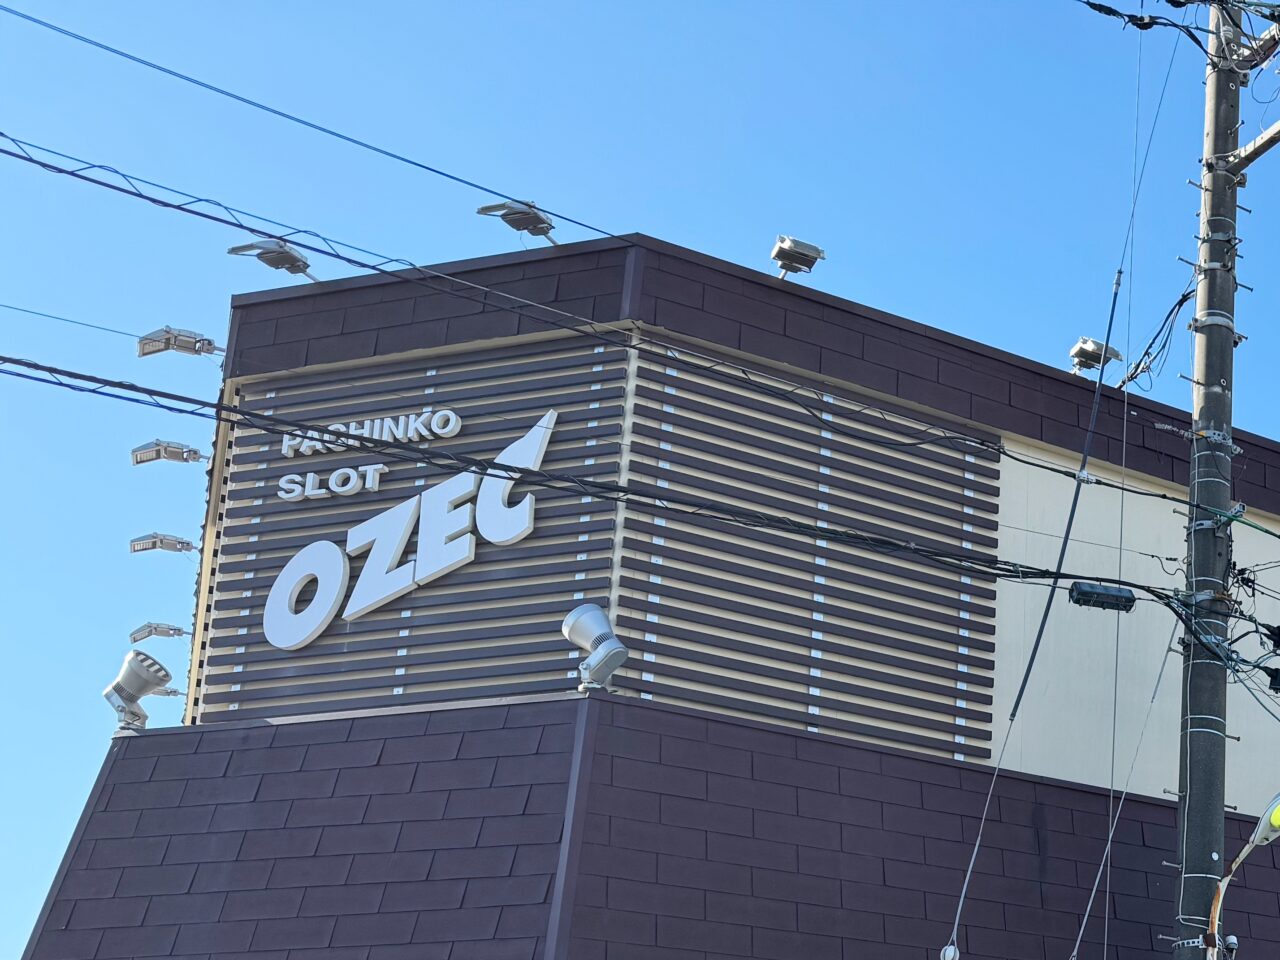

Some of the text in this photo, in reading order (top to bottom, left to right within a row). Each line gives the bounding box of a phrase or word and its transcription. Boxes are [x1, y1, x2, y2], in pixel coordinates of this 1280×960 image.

[281, 409, 462, 458] PACHINKO
[277, 463, 389, 501] SLOT
[263, 408, 558, 651] OZEC
